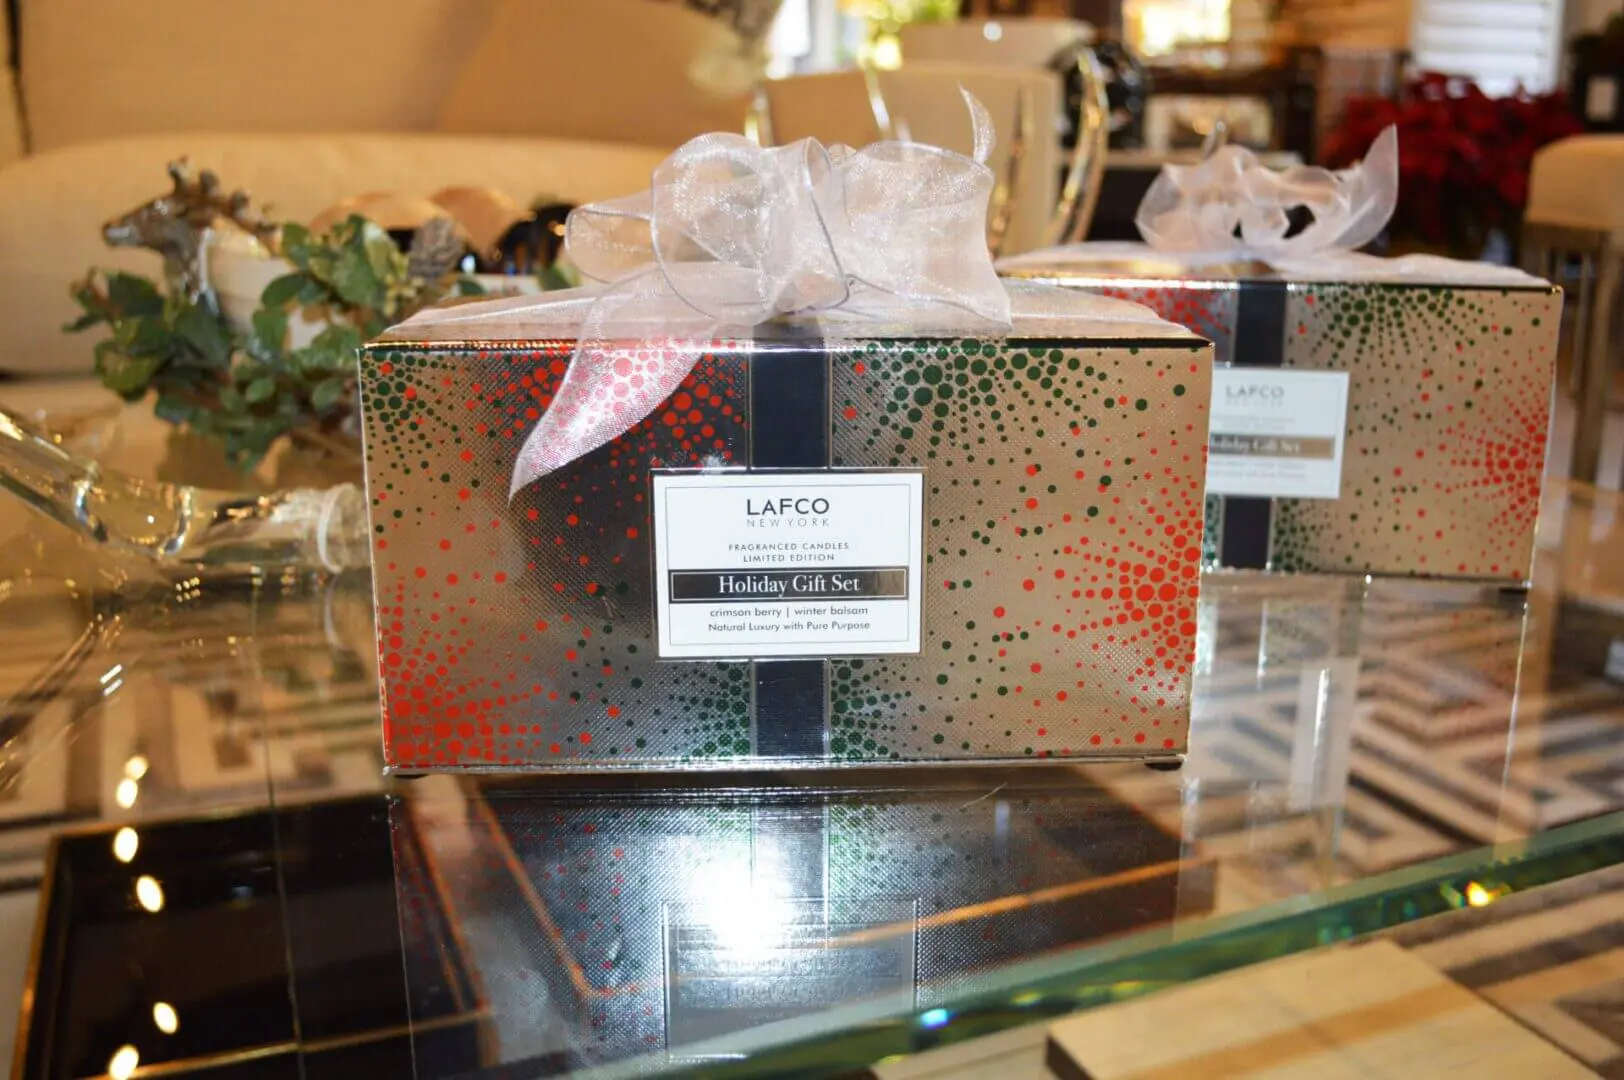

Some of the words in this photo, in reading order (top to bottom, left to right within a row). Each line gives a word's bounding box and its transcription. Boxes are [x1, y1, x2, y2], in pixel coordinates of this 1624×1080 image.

[1225, 385, 1284, 398] LAFCO
[746, 498, 830, 515] LAFCO
[746, 518, 780, 528] NEW
[787, 517, 830, 527] YORK
[728, 543, 797, 552] FRAGRANCED
[802, 542, 849, 551] CANDLES
[743, 554, 785, 562] LIMITED
[790, 553, 835, 562] EDITION
[718, 575, 788, 597] Holiday
[792, 575, 827, 592] Gift
[831, 574, 859, 592] Set
[710, 608, 751, 617] crimson
[755, 606, 782, 618] berry
[794, 606, 827, 616] winter
[830, 605, 868, 615] balsam
[708, 622, 746, 632] Natural
[749, 622, 780, 632] Luxury
[783, 621, 803, 630] with
[806, 621, 829, 630] Pure
[831, 620, 870, 631] Purpose
